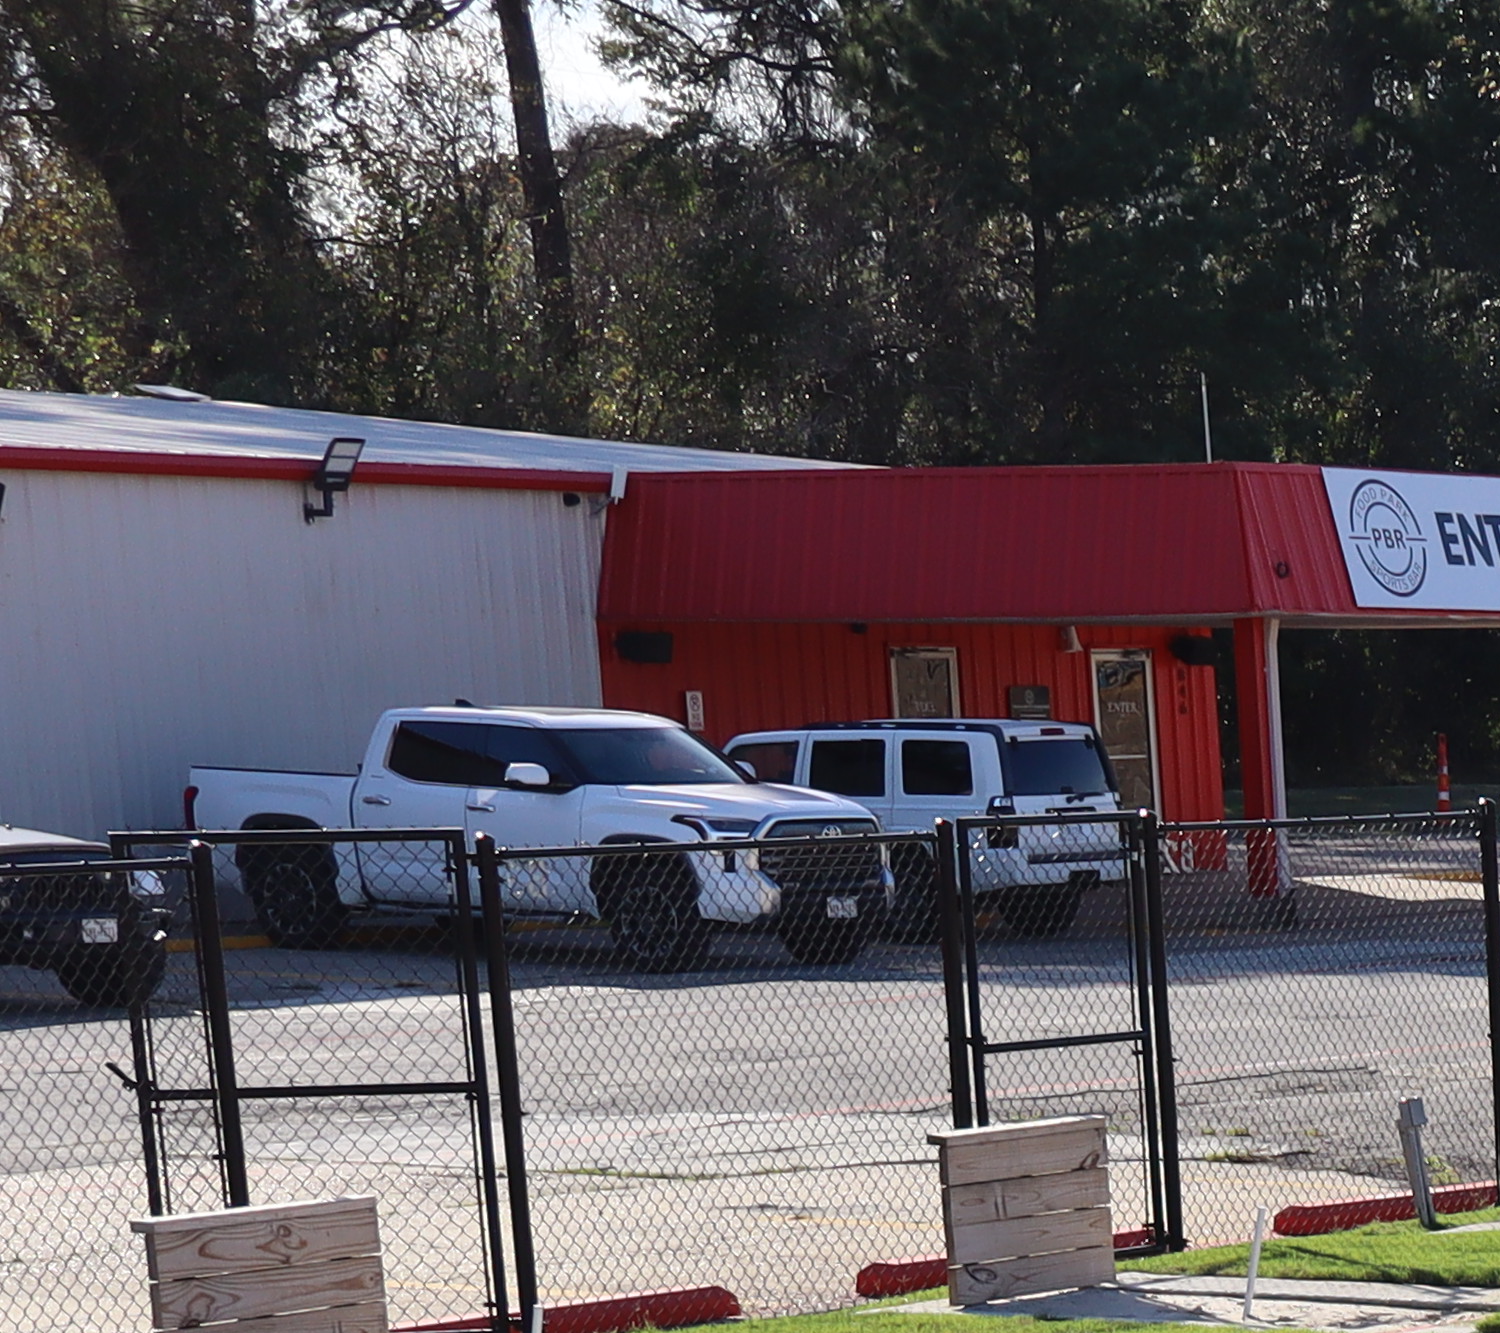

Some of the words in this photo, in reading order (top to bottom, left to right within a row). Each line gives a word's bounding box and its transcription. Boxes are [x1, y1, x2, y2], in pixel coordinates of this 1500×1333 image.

[1354, 487, 1377, 519] FOOD
[1380, 488, 1409, 522] PARK
[1371, 528, 1407, 550] PBR
[1369, 560, 1409, 591] SPORTS
[1408, 562, 1423, 586] BAR
